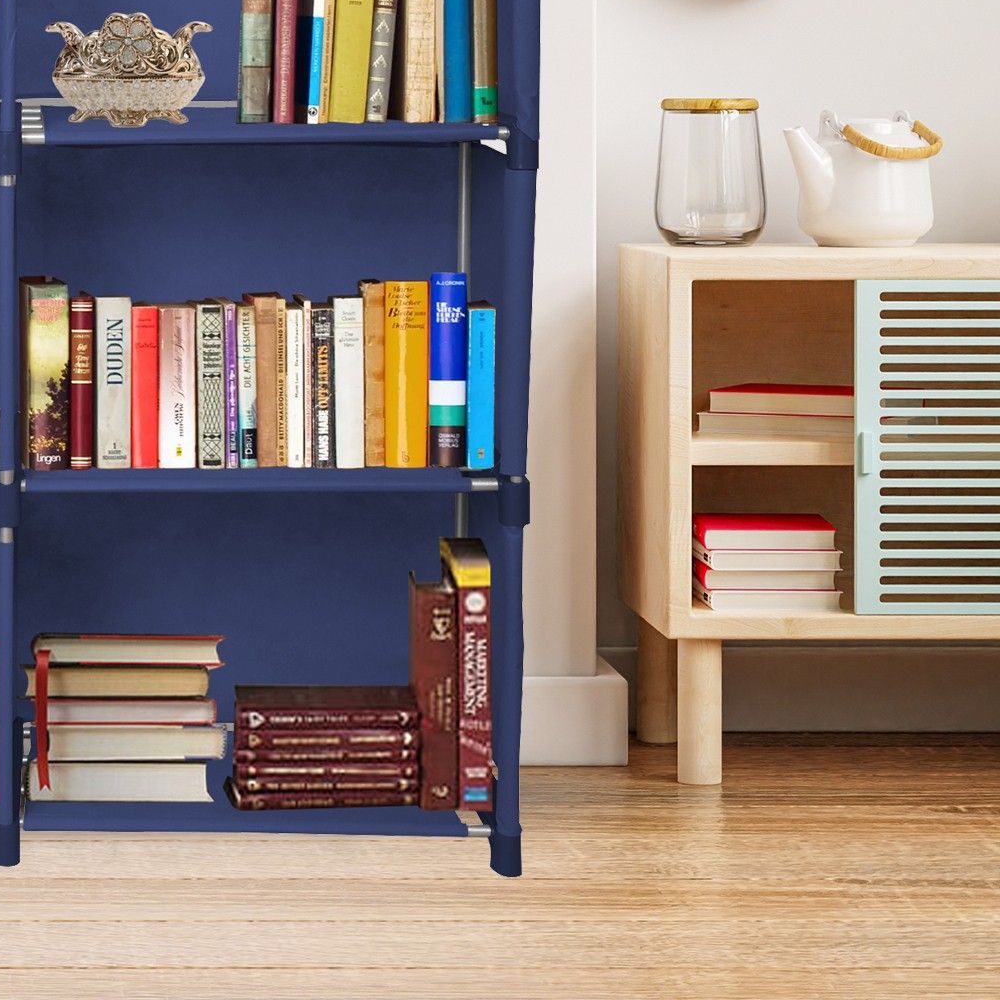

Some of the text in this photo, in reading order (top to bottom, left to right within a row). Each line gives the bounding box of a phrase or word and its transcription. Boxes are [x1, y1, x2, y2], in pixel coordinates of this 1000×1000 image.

[242, 312, 250, 352] GESICHTER
[106, 318, 124, 386] DUDEN
[243, 356, 251, 374] ACHT
[244, 434, 253, 454] Daut
[318, 410, 328, 460] HANS HABE
[36, 453, 62, 464] Lingen
